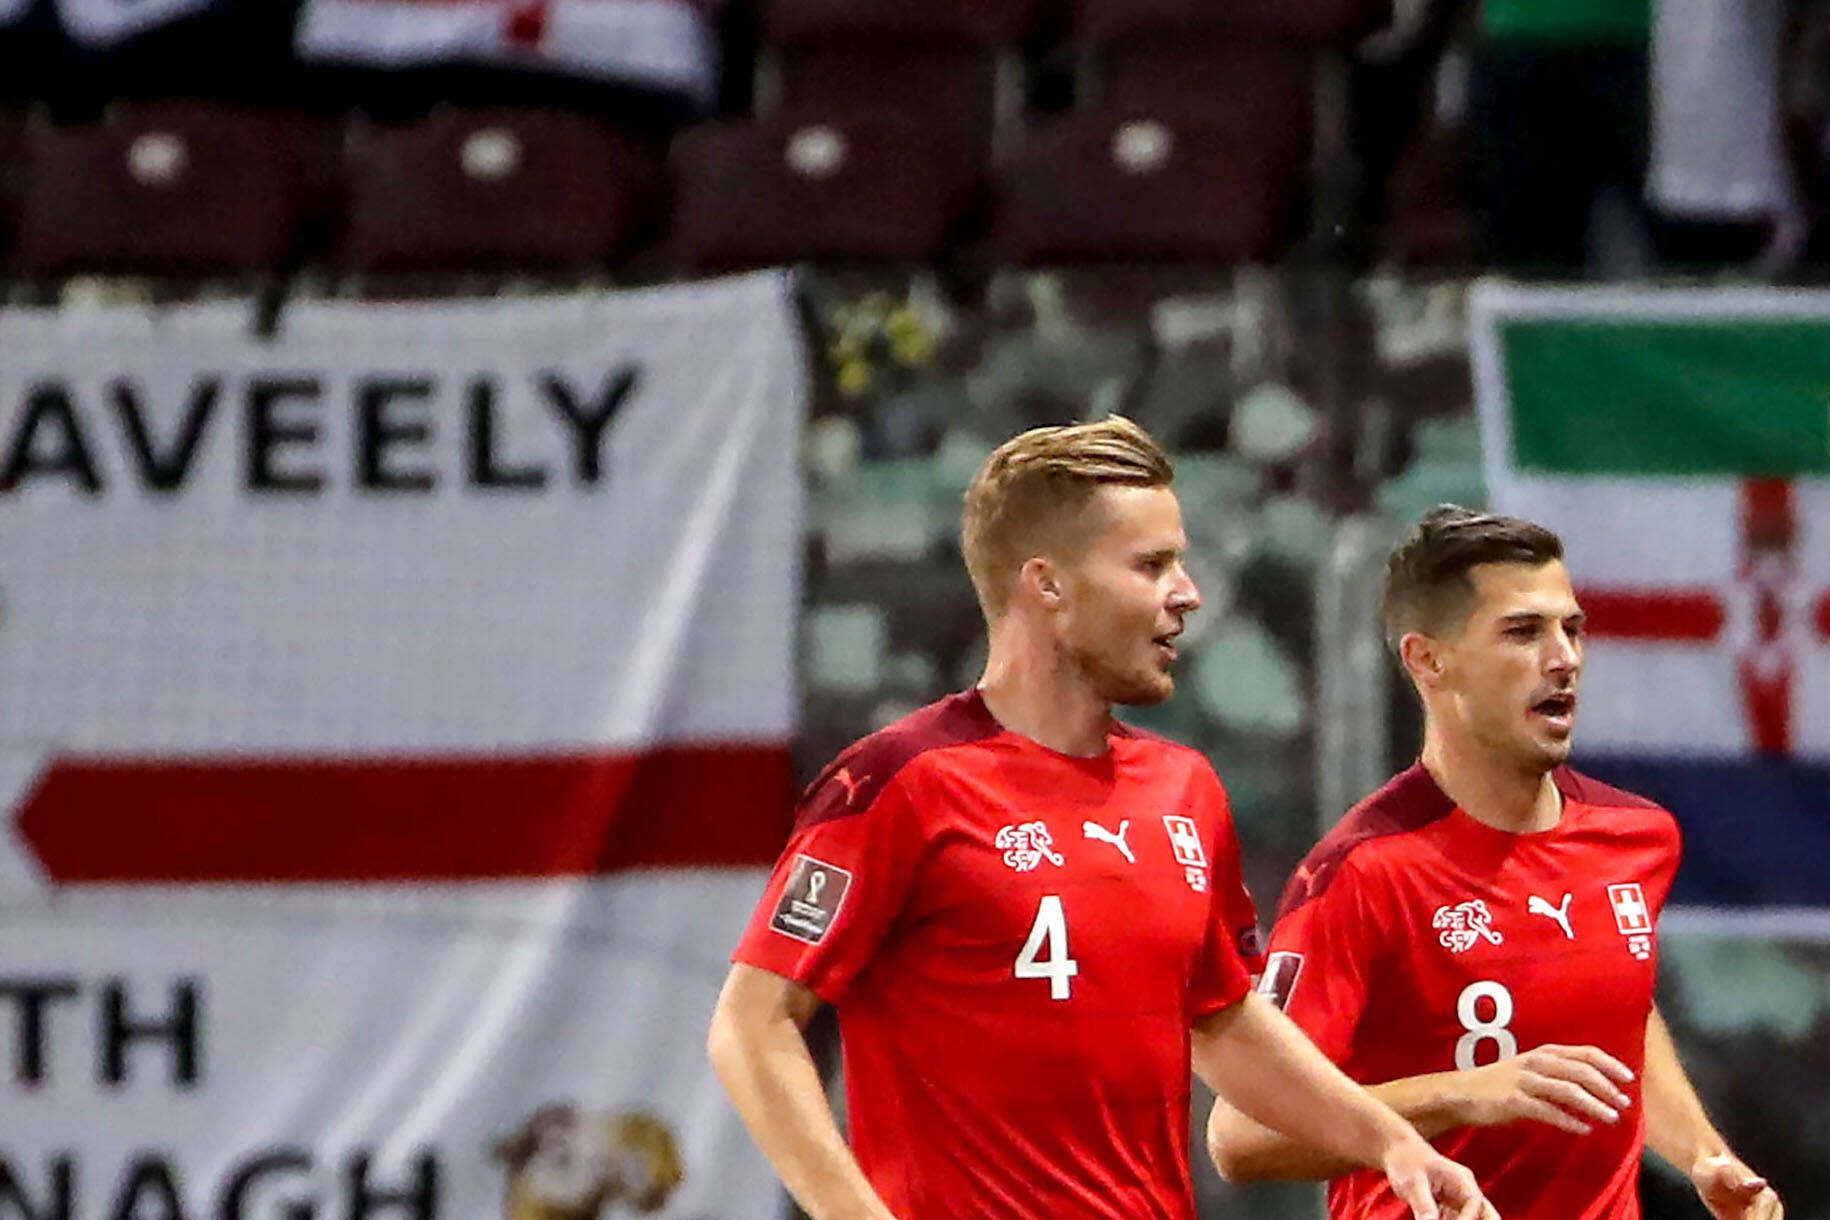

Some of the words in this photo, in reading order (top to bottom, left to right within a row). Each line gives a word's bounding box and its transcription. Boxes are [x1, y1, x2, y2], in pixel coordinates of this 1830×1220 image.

[0, 362, 641, 494] AVEELY
[1014, 896, 1078, 999] 4
[0, 975, 204, 1086] TH
[1455, 981, 1518, 1072] 8
